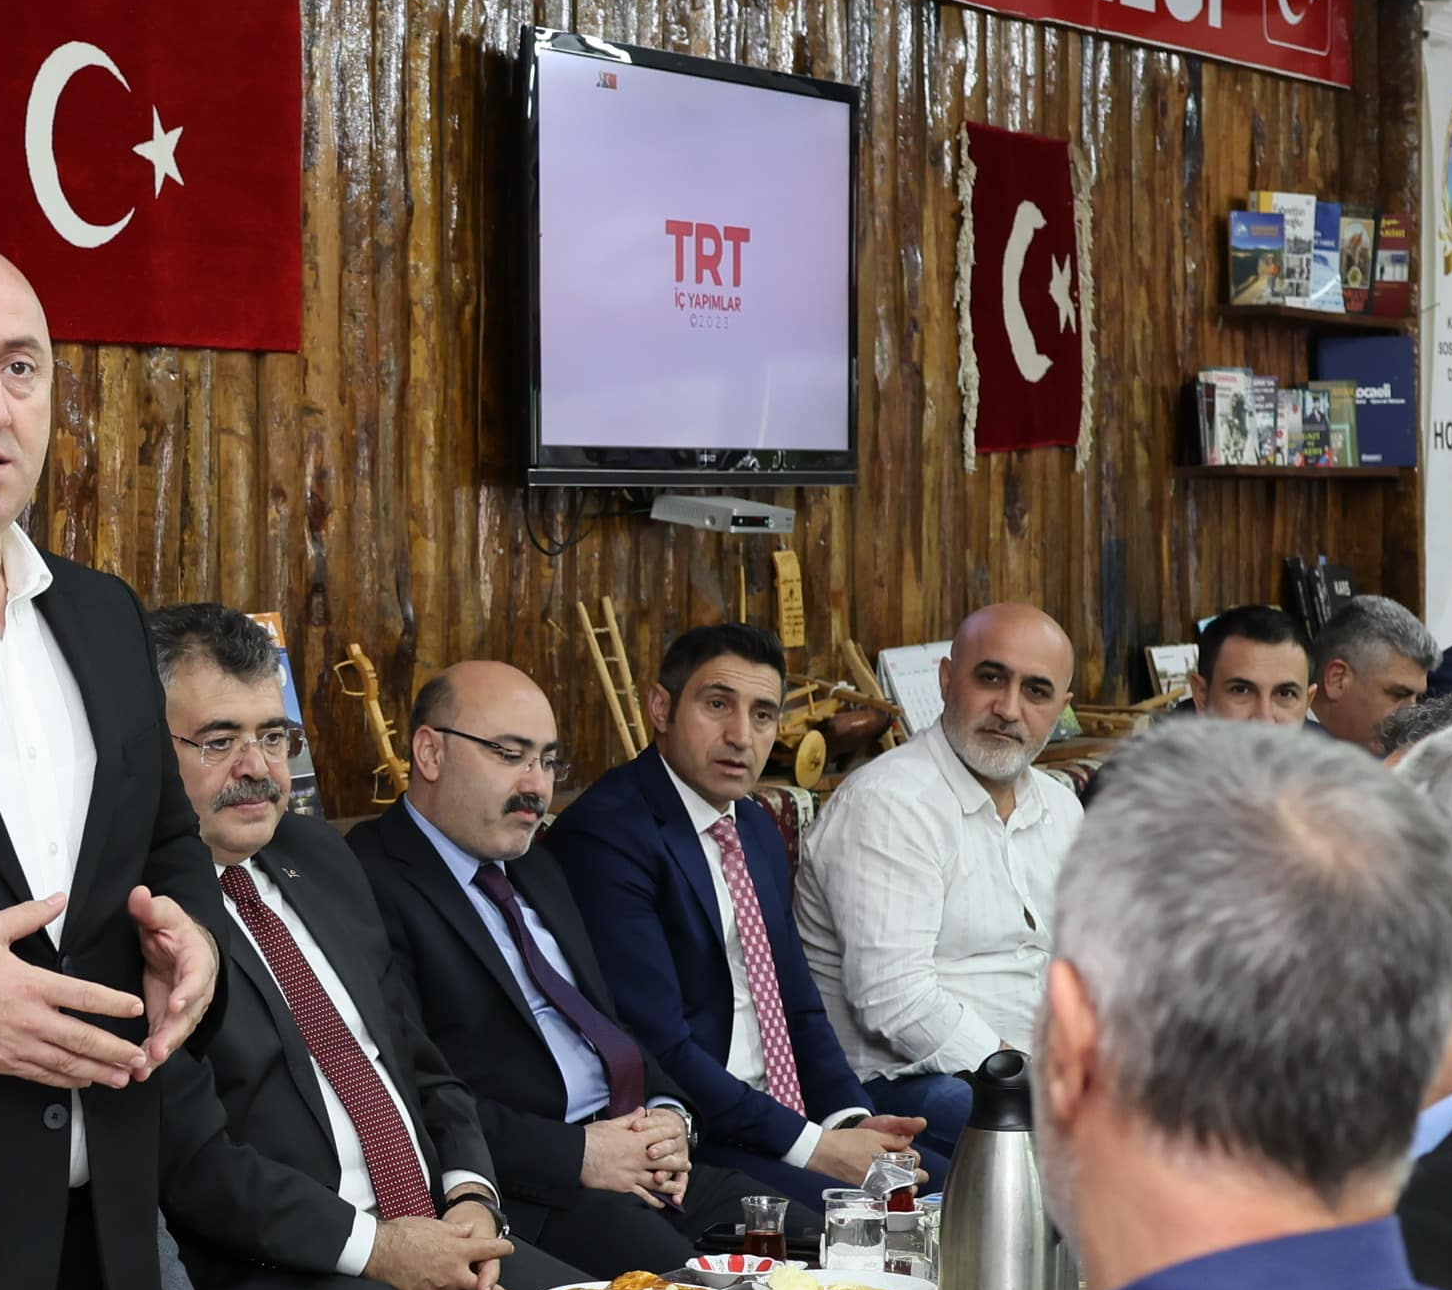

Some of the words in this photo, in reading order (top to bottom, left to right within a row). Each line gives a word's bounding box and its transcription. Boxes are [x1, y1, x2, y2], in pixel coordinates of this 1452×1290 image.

[664, 219, 751, 288] TRT
[674, 287, 686, 312] İÇ
[687, 292, 742, 313] YAPIMLAR
